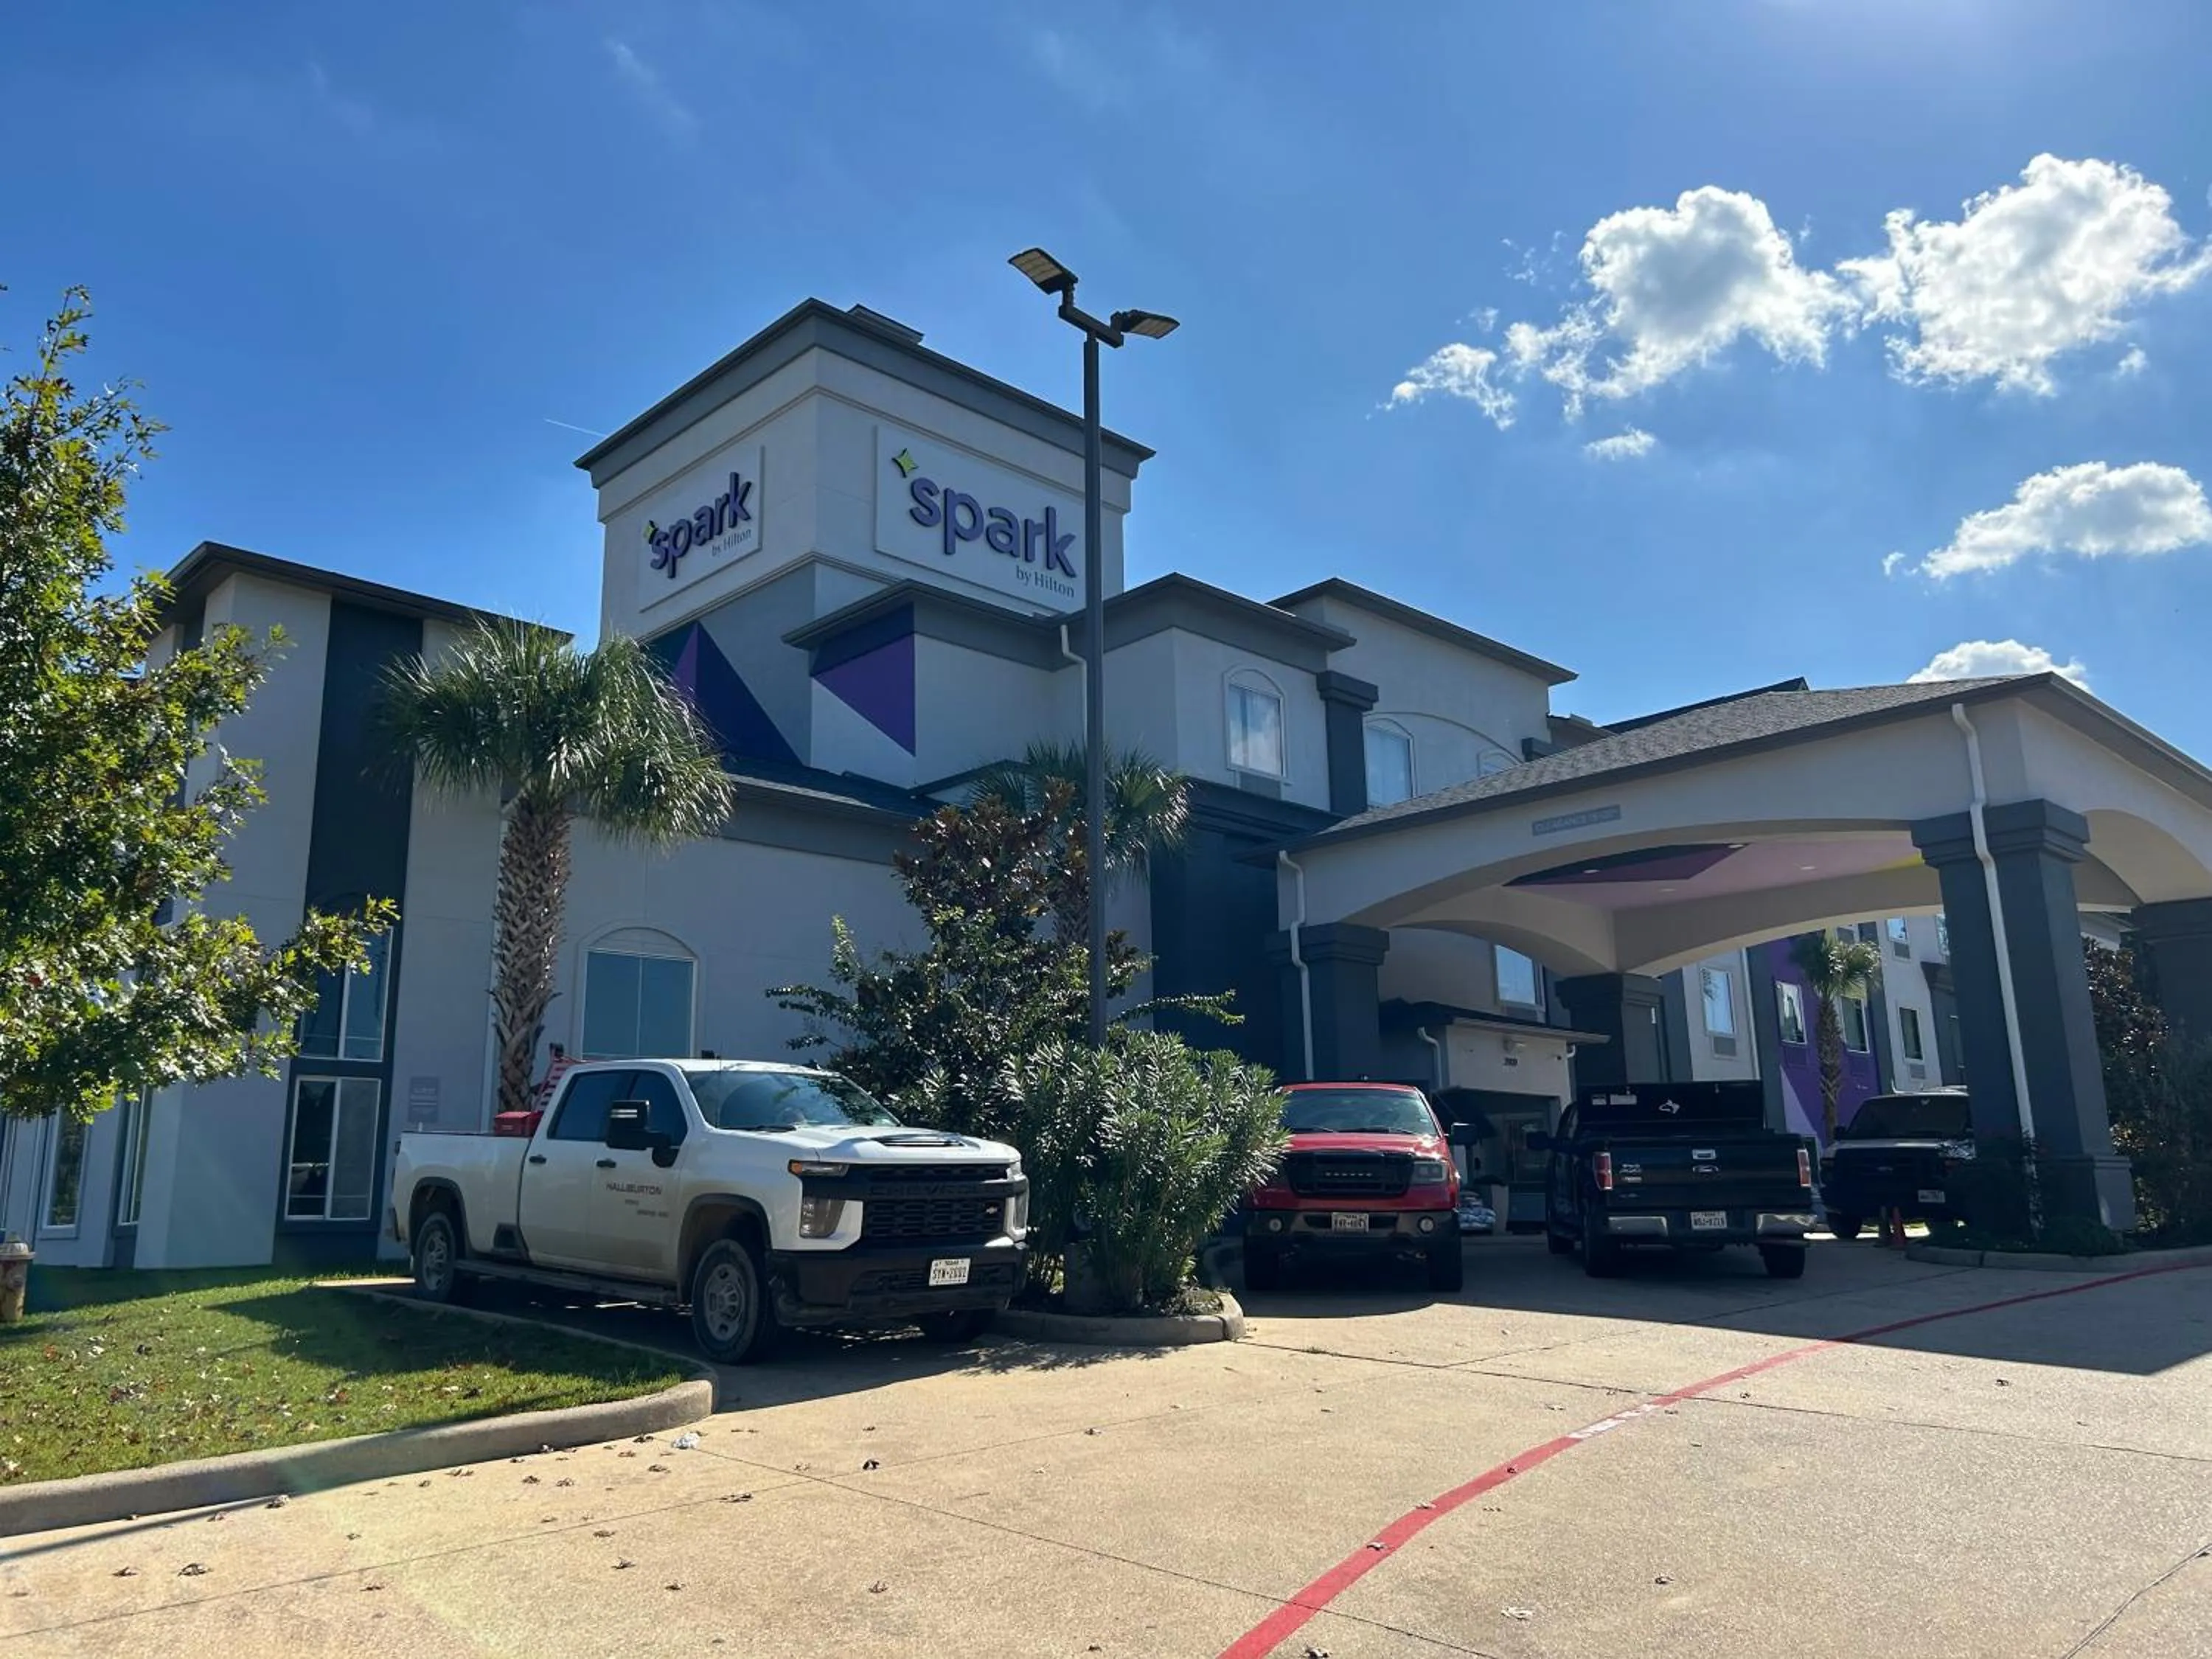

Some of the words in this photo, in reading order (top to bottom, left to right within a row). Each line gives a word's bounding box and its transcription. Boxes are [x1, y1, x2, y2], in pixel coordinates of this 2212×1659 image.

[650, 472, 752, 579] spark
[723, 529, 751, 550] Hilton
[909, 477, 1077, 578] spark
[1016, 565, 1032, 586] by
[1034, 572, 1074, 598] Hilton
[606, 1182, 661, 1195] HALLIBURTON
